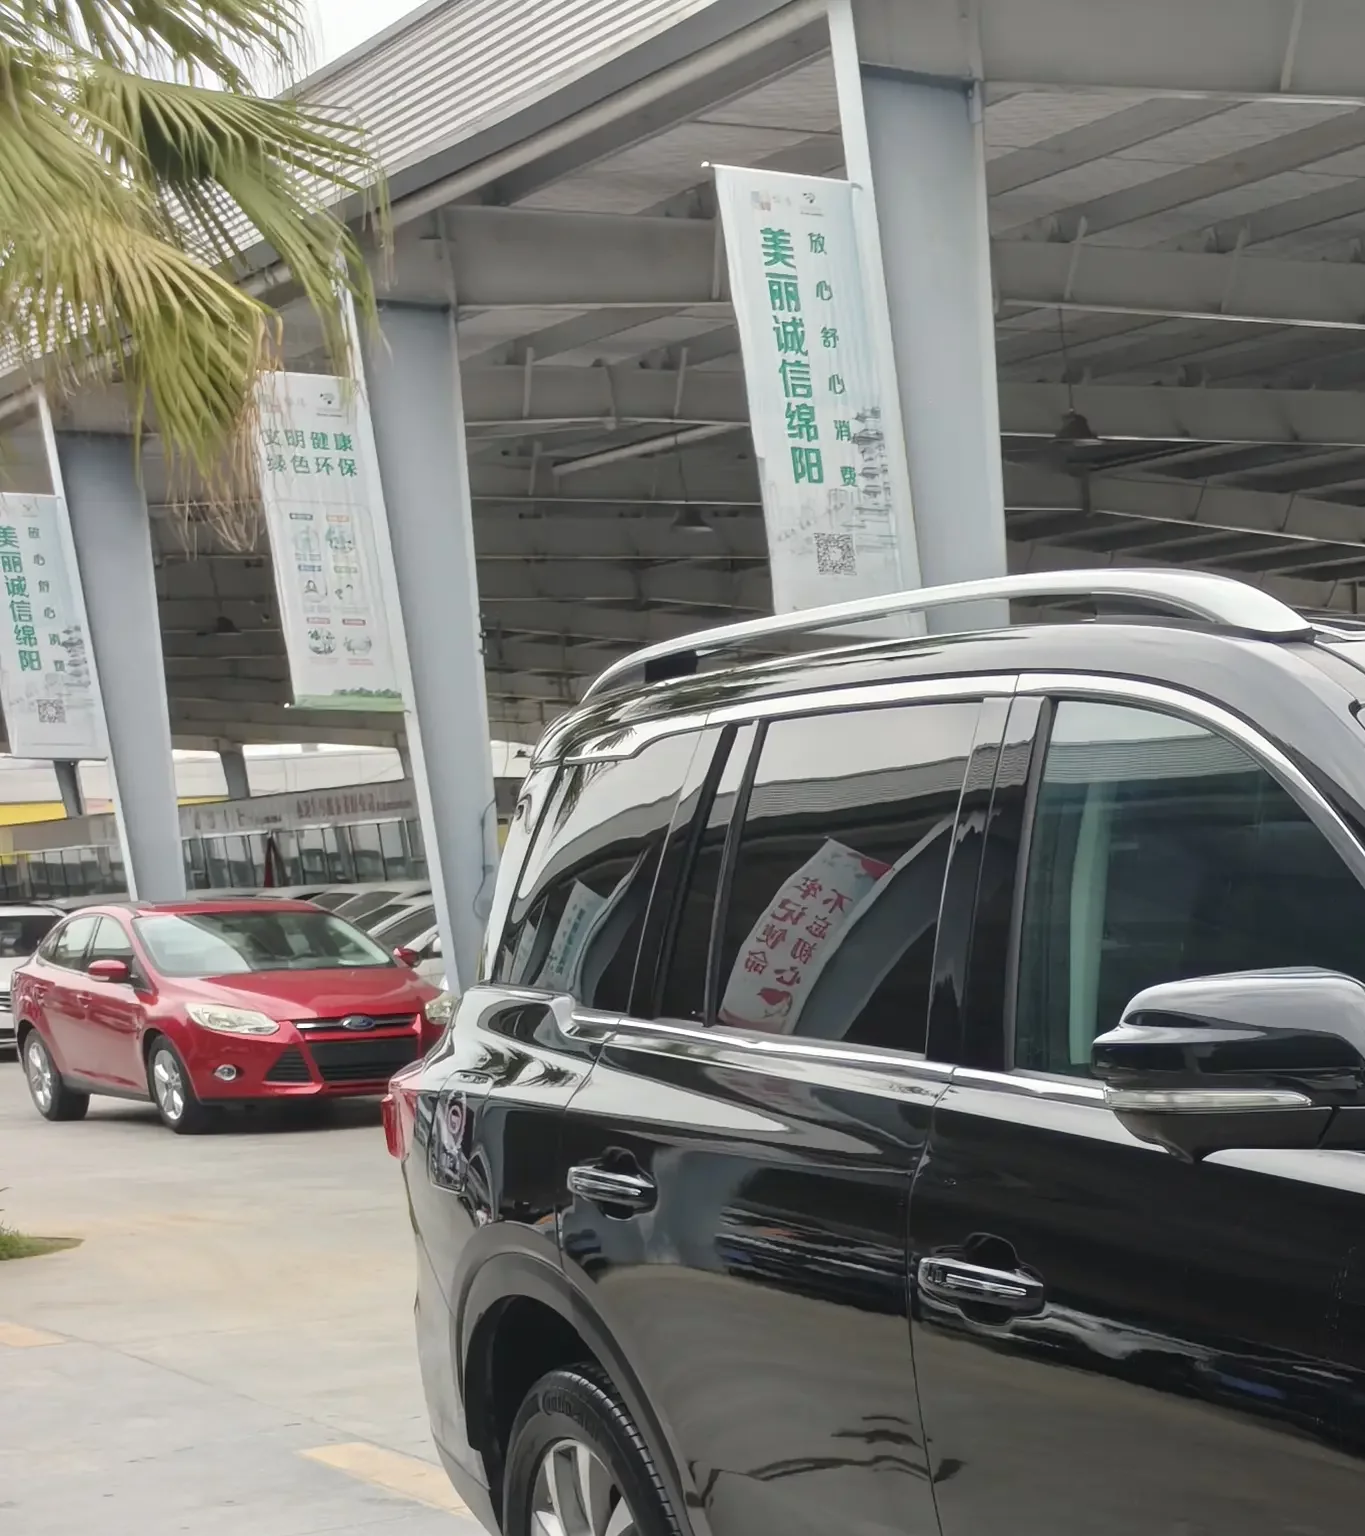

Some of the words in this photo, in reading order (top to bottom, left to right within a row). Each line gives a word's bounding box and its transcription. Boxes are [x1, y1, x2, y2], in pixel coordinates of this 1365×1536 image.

[760, 227, 824, 486] 美丽诚信绵阳
[807, 231, 859, 488] 放心舒心消费
[261, 428, 354, 452] 文明健康
[266, 453, 358, 478] 绿色环保
[0, 526, 42, 671] 美丽诚信绵阳
